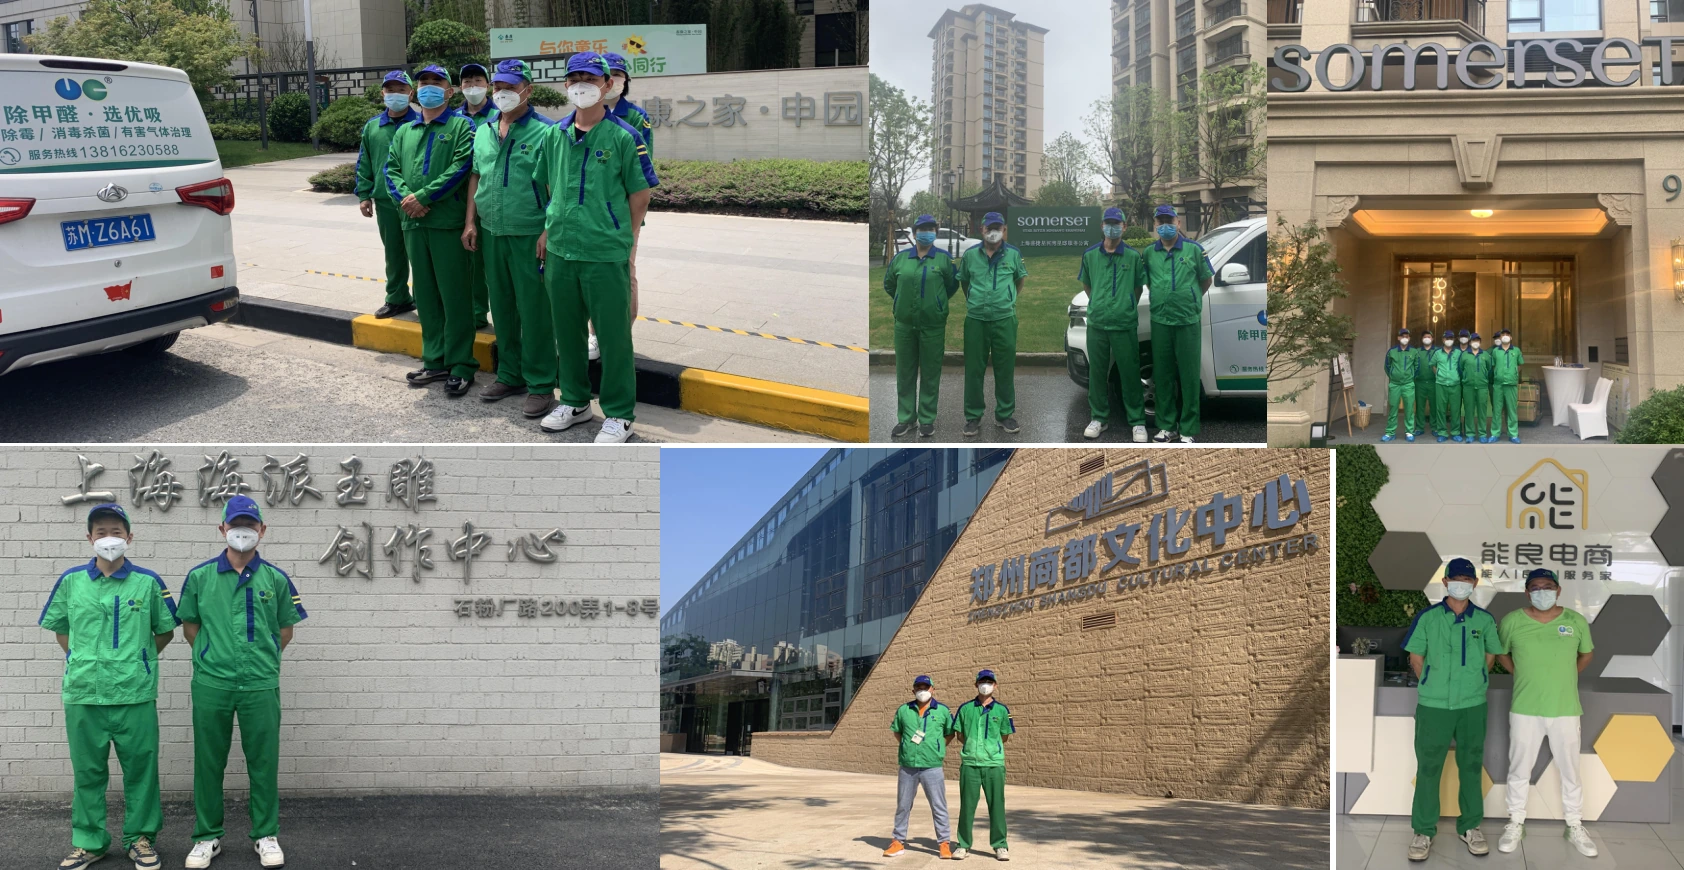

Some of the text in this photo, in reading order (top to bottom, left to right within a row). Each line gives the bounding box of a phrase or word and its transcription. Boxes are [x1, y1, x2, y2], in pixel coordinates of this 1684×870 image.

[638, 91, 863, 128] 康之家·申园
[60, 449, 438, 513] 上海海派玉雕
[317, 517, 568, 585] 创作中心
[969, 473, 1312, 605] 郑州商都文化中心
[1039, 580, 1107, 608] SHANGDU
[1116, 557, 1214, 593] CULTURAL
[1220, 533, 1319, 568] CENTER
[1480, 541, 1613, 567] 能良电商
